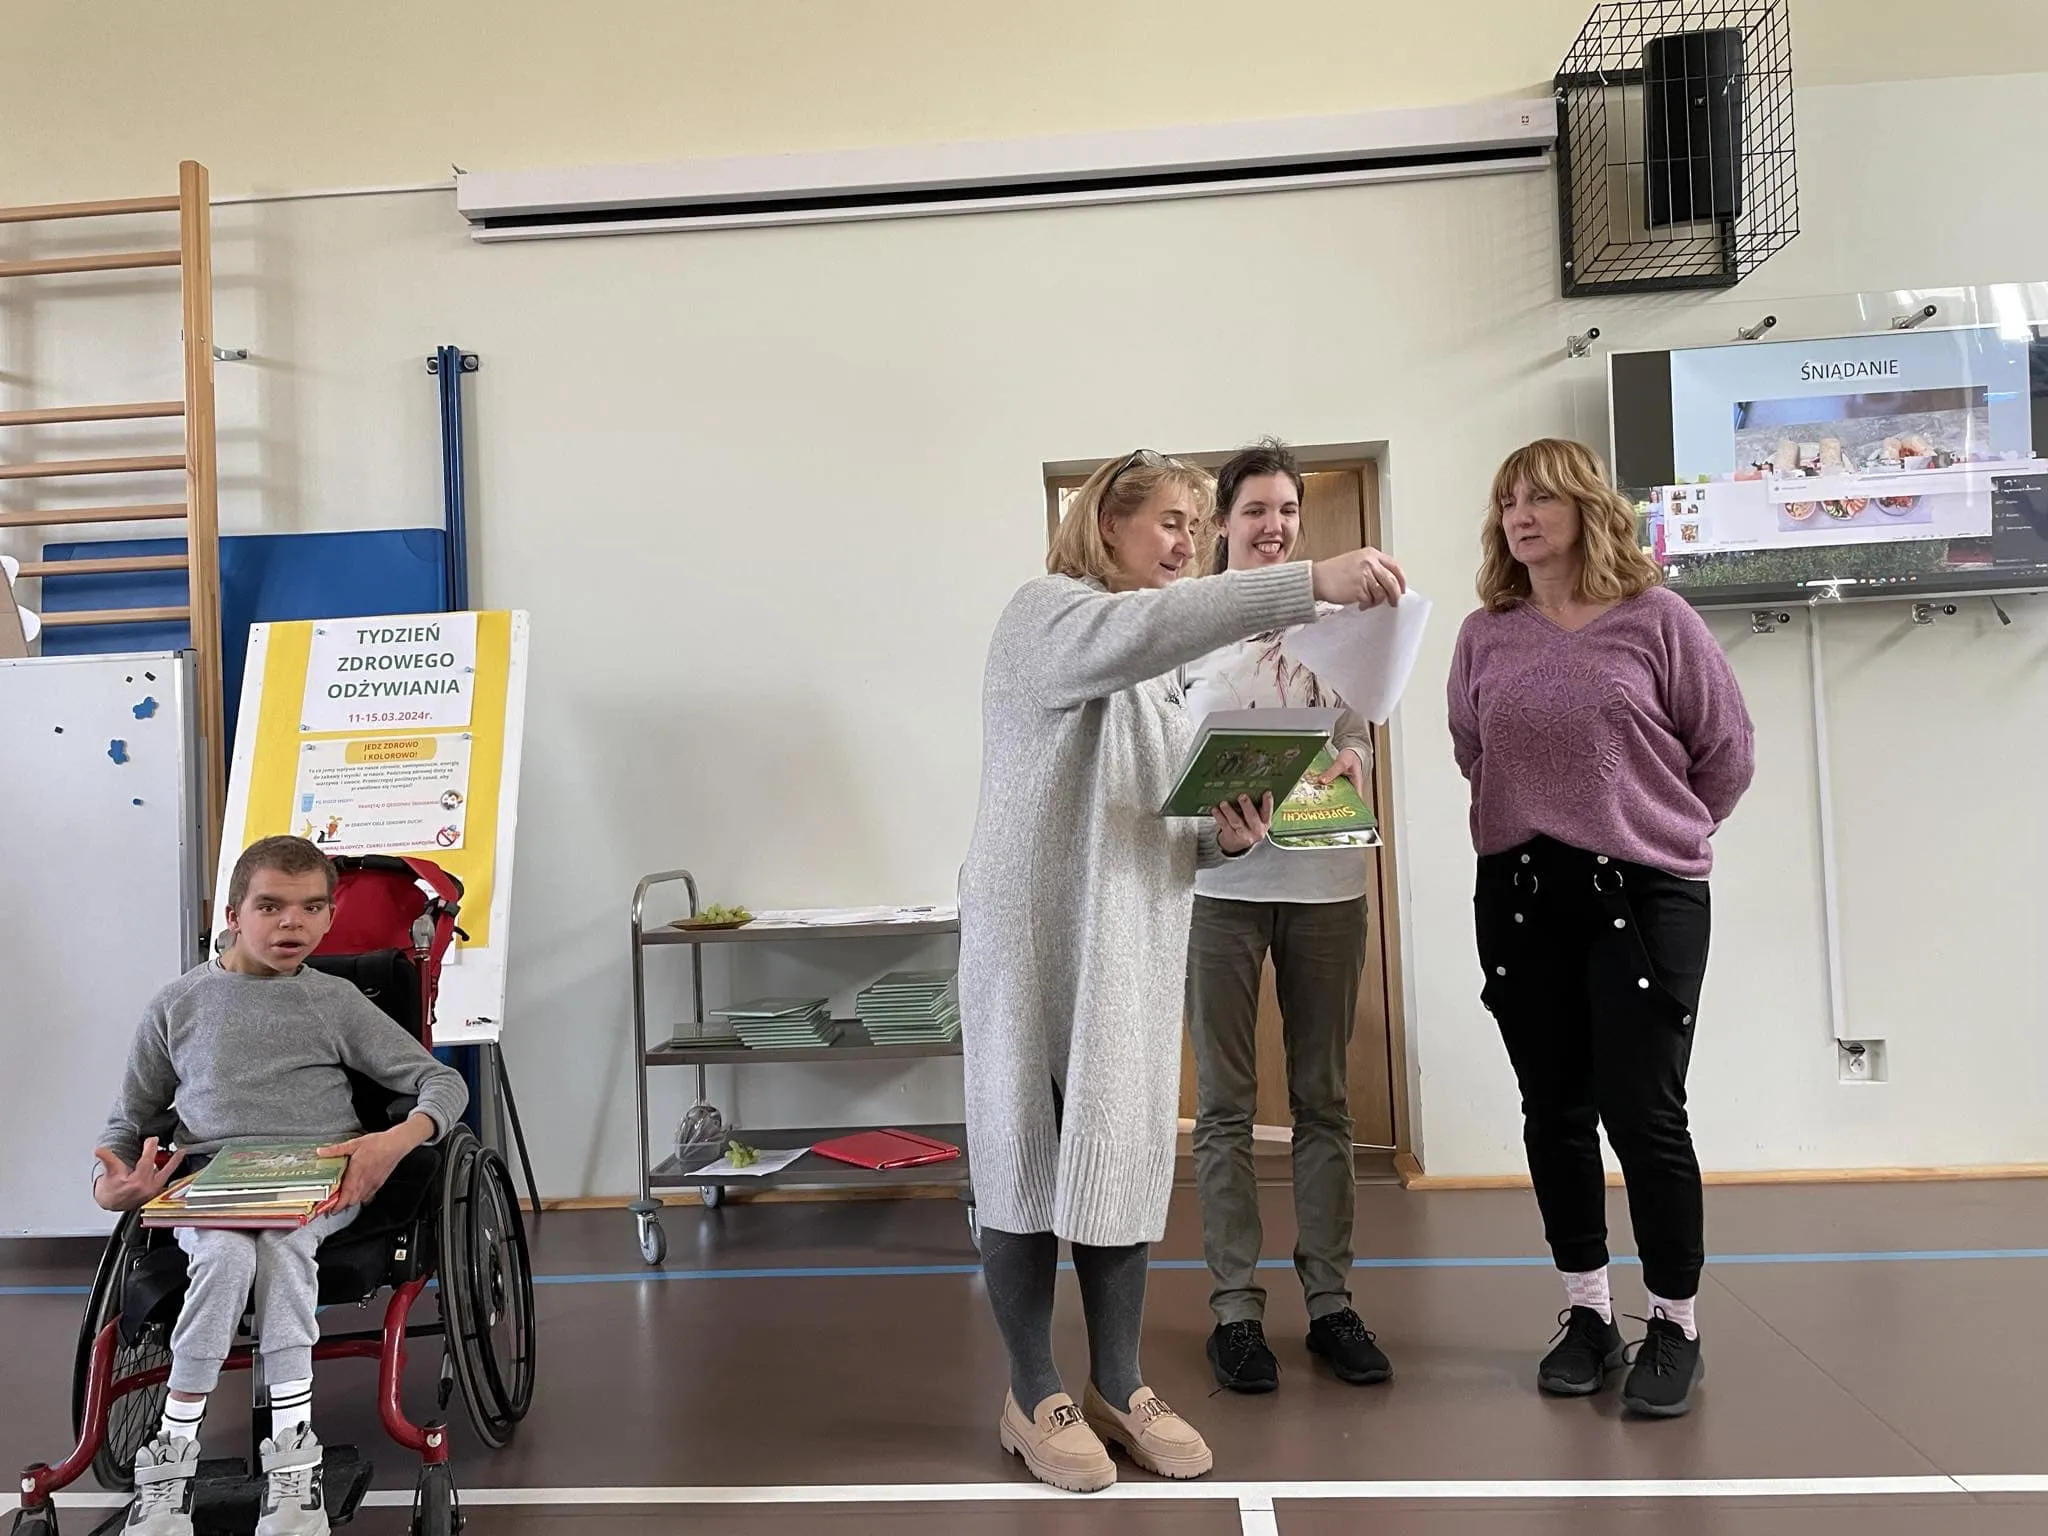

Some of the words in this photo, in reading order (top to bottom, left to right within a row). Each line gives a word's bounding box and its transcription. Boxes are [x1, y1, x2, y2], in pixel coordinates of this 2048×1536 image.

[1801, 359, 1899, 381] ŚNIADANIE
[357, 622, 440, 644] TYDZIEŃ
[337, 652, 455, 672] ZDROWEGO
[327, 679, 460, 698] ODŻYWIANIA
[348, 711, 433, 722] 11-15.03.2024r.
[363, 743, 382, 751] JEDZ
[383, 741, 419, 750] ZDROWO
[1282, 806, 1356, 822] SUPERMOCNI
